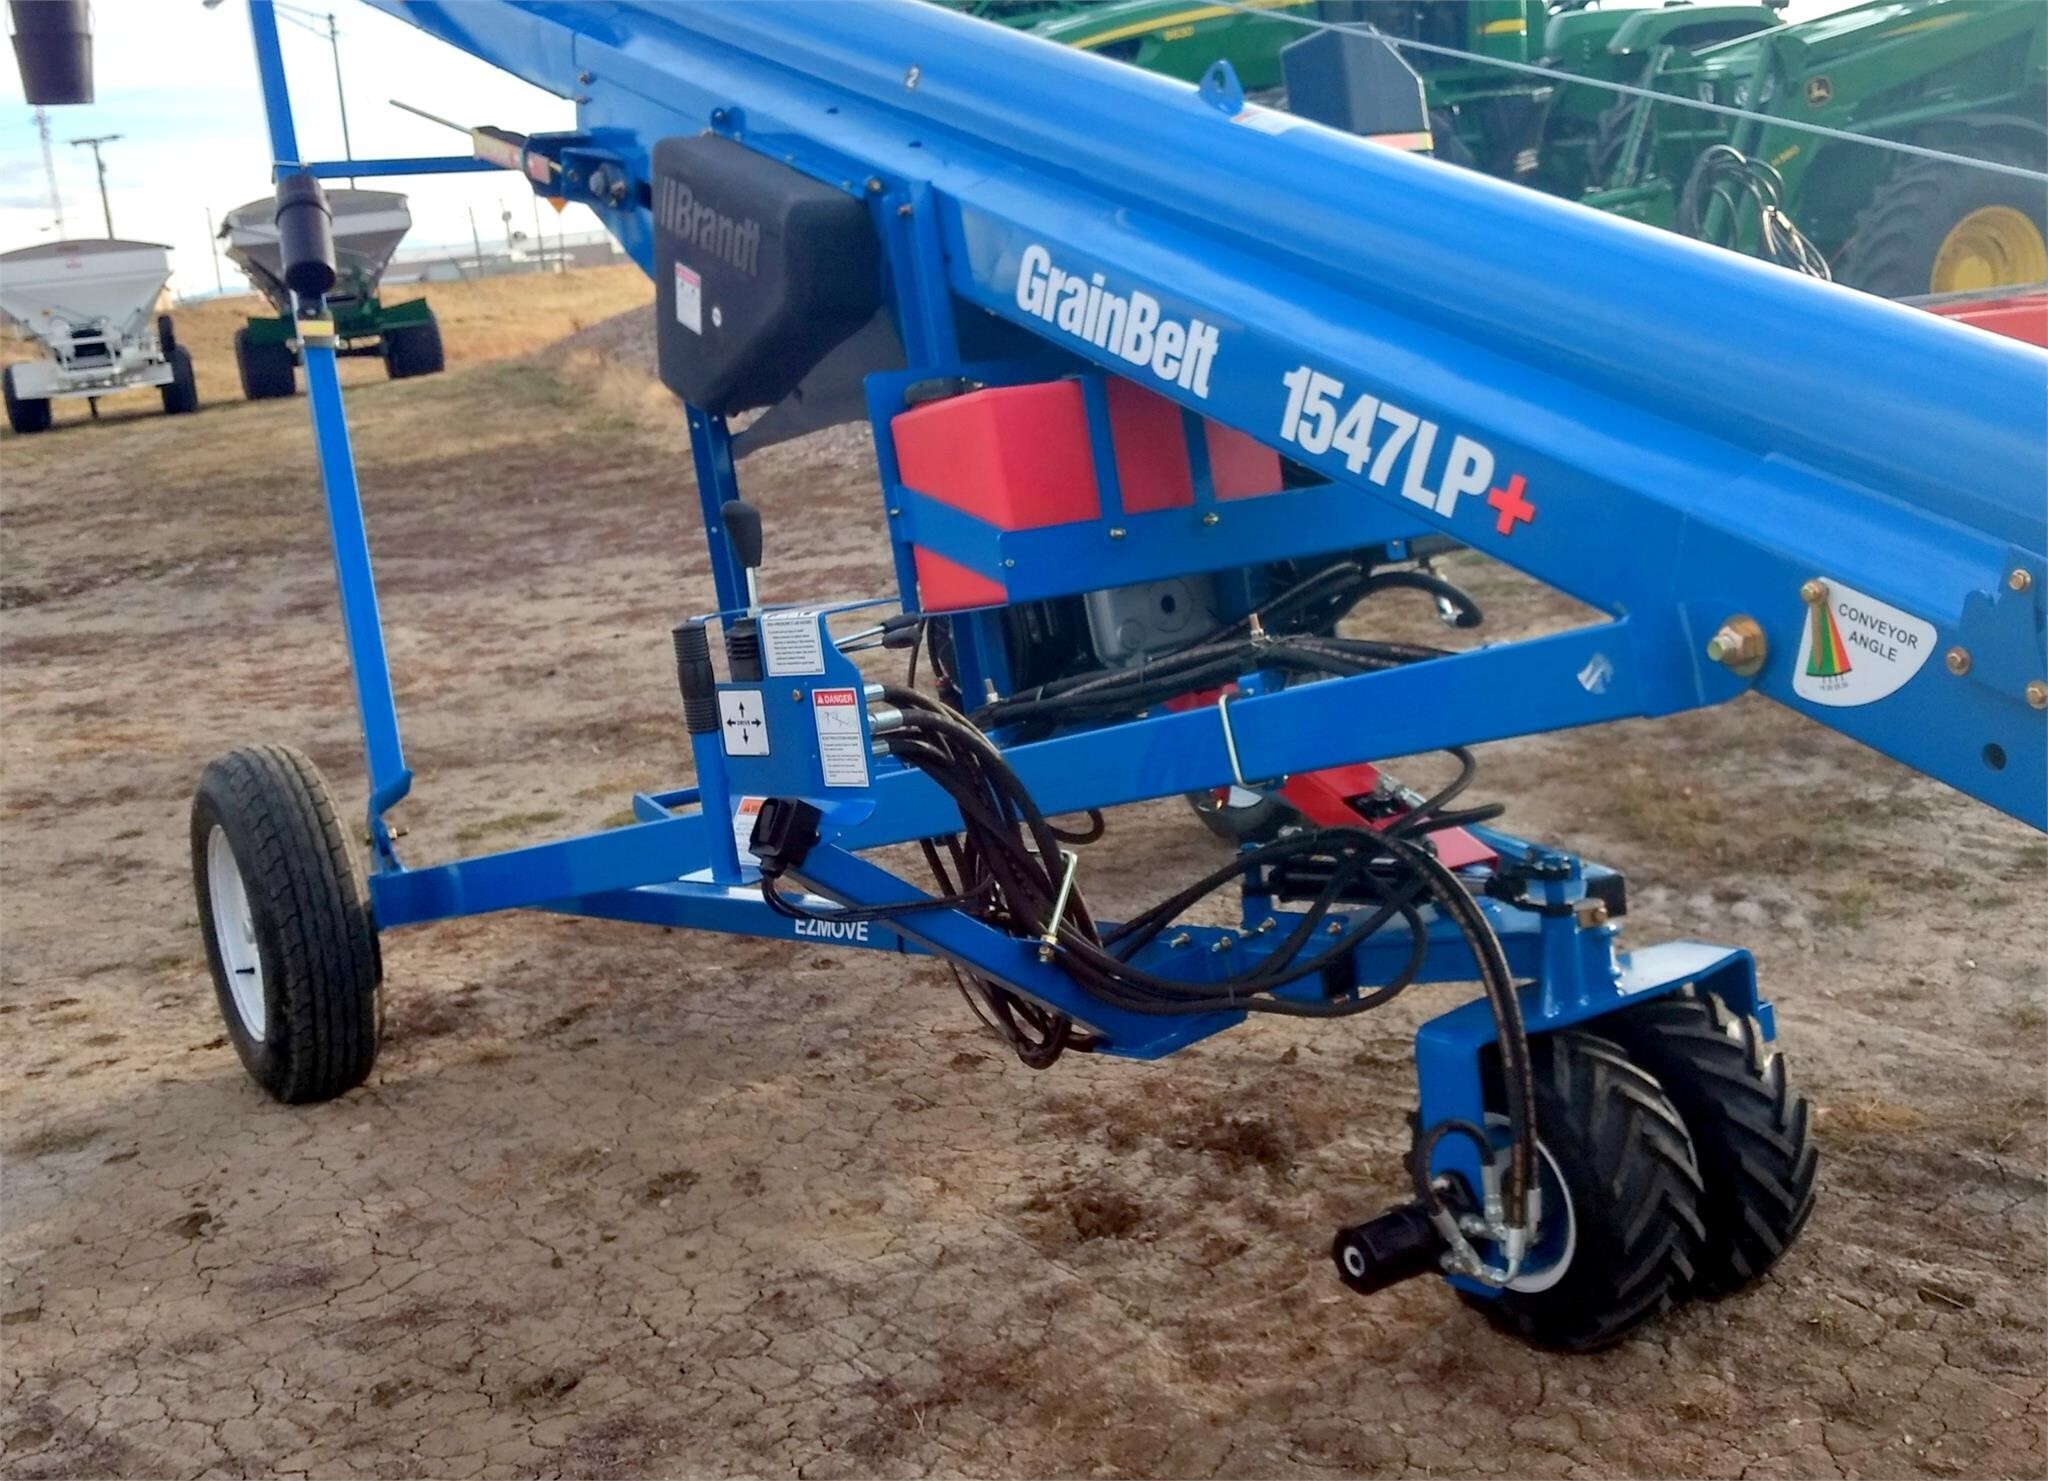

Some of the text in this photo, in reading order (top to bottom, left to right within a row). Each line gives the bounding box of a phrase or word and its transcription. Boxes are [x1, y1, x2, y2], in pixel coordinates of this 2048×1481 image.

[674, 185, 760, 275] Brandt
[1015, 244, 1220, 399] GrainBelt
[1839, 603, 1918, 648] CONVEYOR
[1848, 630, 1898, 663] ANGLE
[823, 694, 854, 705] DANGER
[794, 918, 869, 942] EZMOVE
